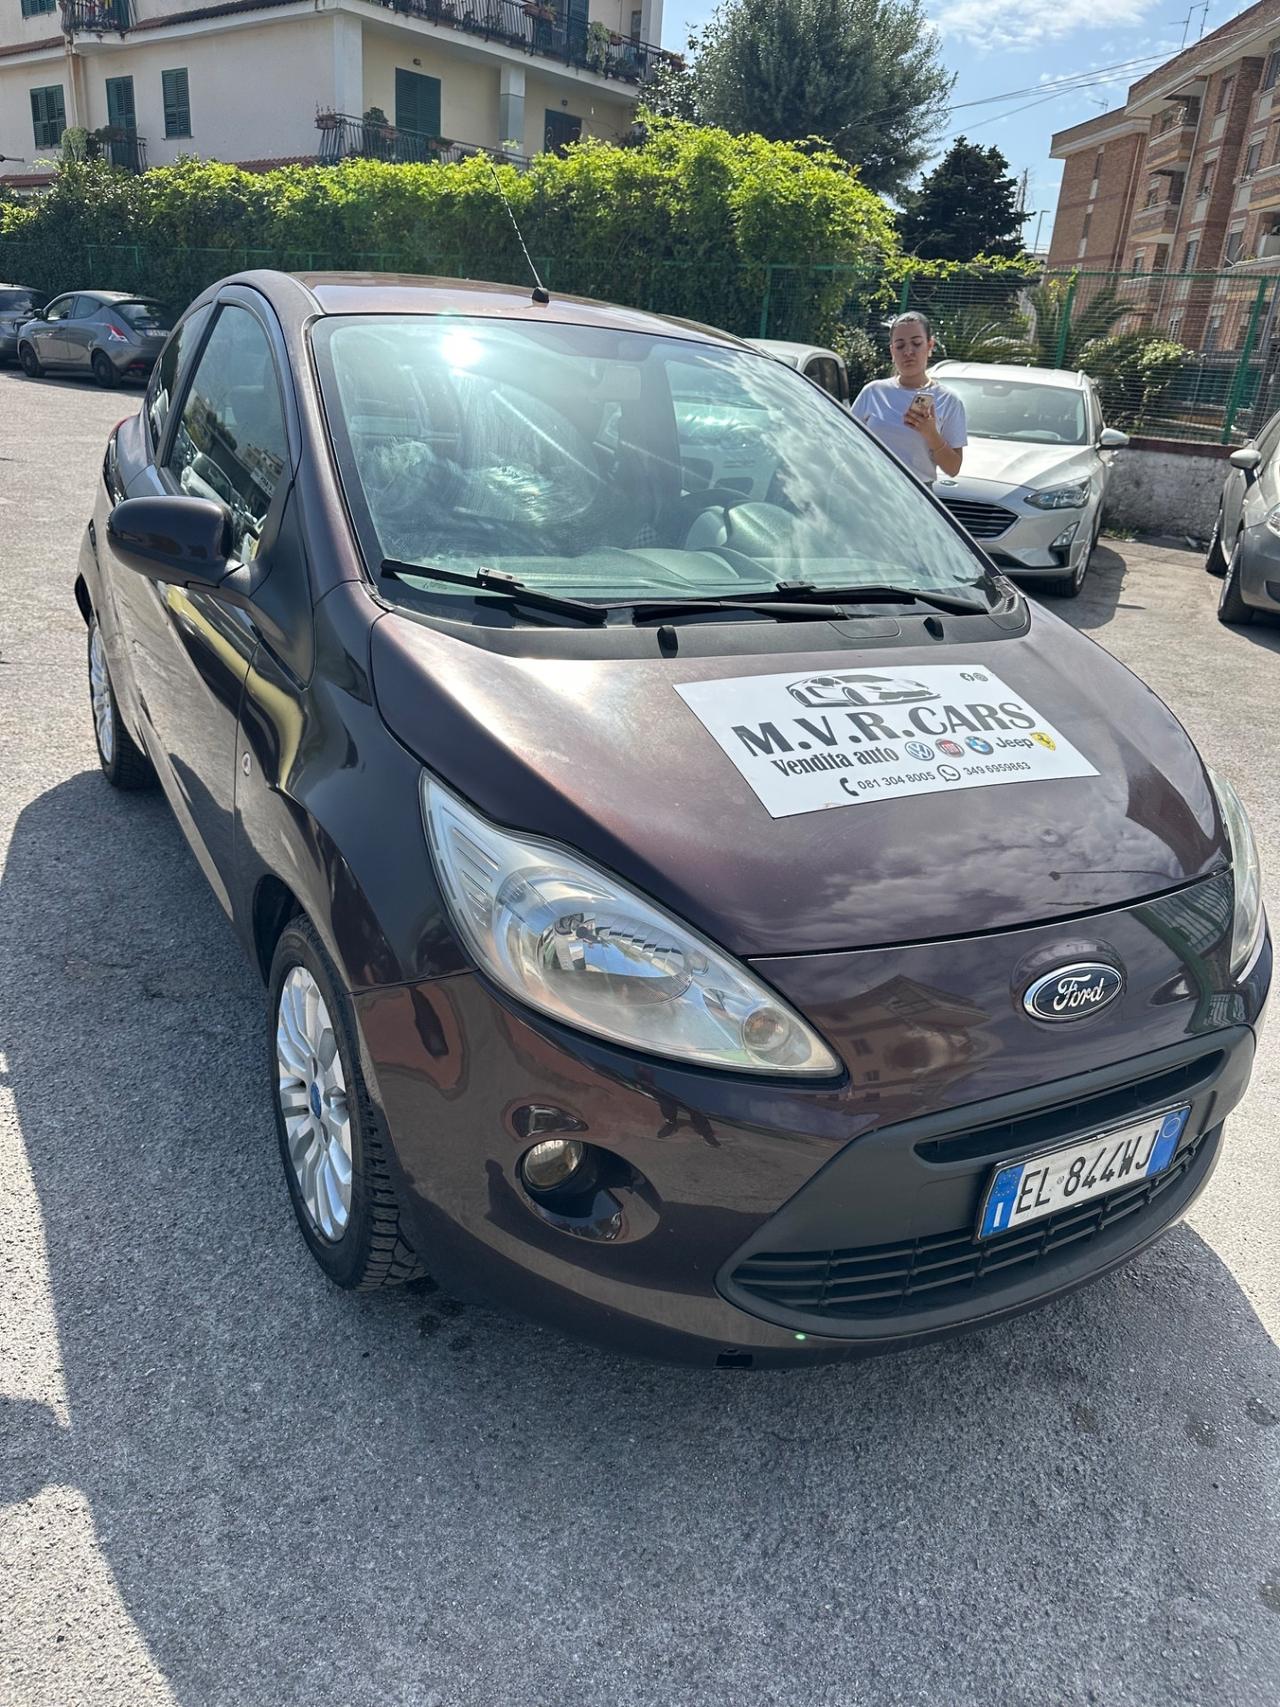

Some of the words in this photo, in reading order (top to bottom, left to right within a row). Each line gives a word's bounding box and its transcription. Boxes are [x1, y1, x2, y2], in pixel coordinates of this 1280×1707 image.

[996, 737, 1034, 748] Jeep
[771, 752, 854, 776] Vendita
[853, 746, 899, 766] auto
[963, 765, 985, 776] 349
[857, 778, 881, 790] 081
[882, 774, 906, 787] 304
[905, 771, 936, 783] 8005
[1053, 973, 1105, 1011] Ford
[1015, 1166, 1051, 1214] EL
[1063, 1129, 1159, 1198] 844WJ
